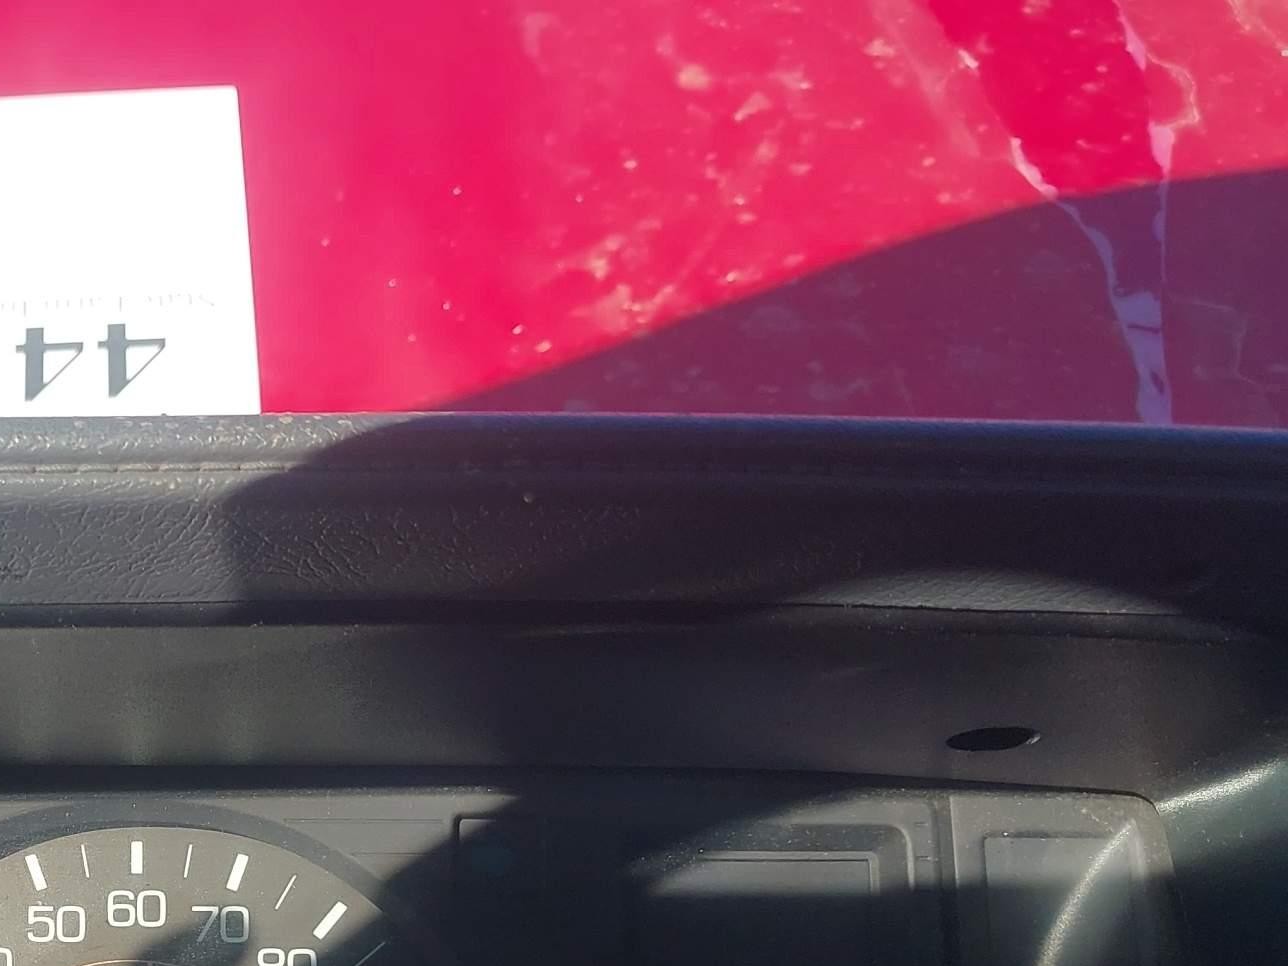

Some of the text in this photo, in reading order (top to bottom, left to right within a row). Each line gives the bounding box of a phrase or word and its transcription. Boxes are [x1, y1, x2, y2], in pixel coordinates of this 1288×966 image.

[26, 905, 87, 943] 50
[106, 889, 167, 928] 60
[190, 905, 250, 943] 70
